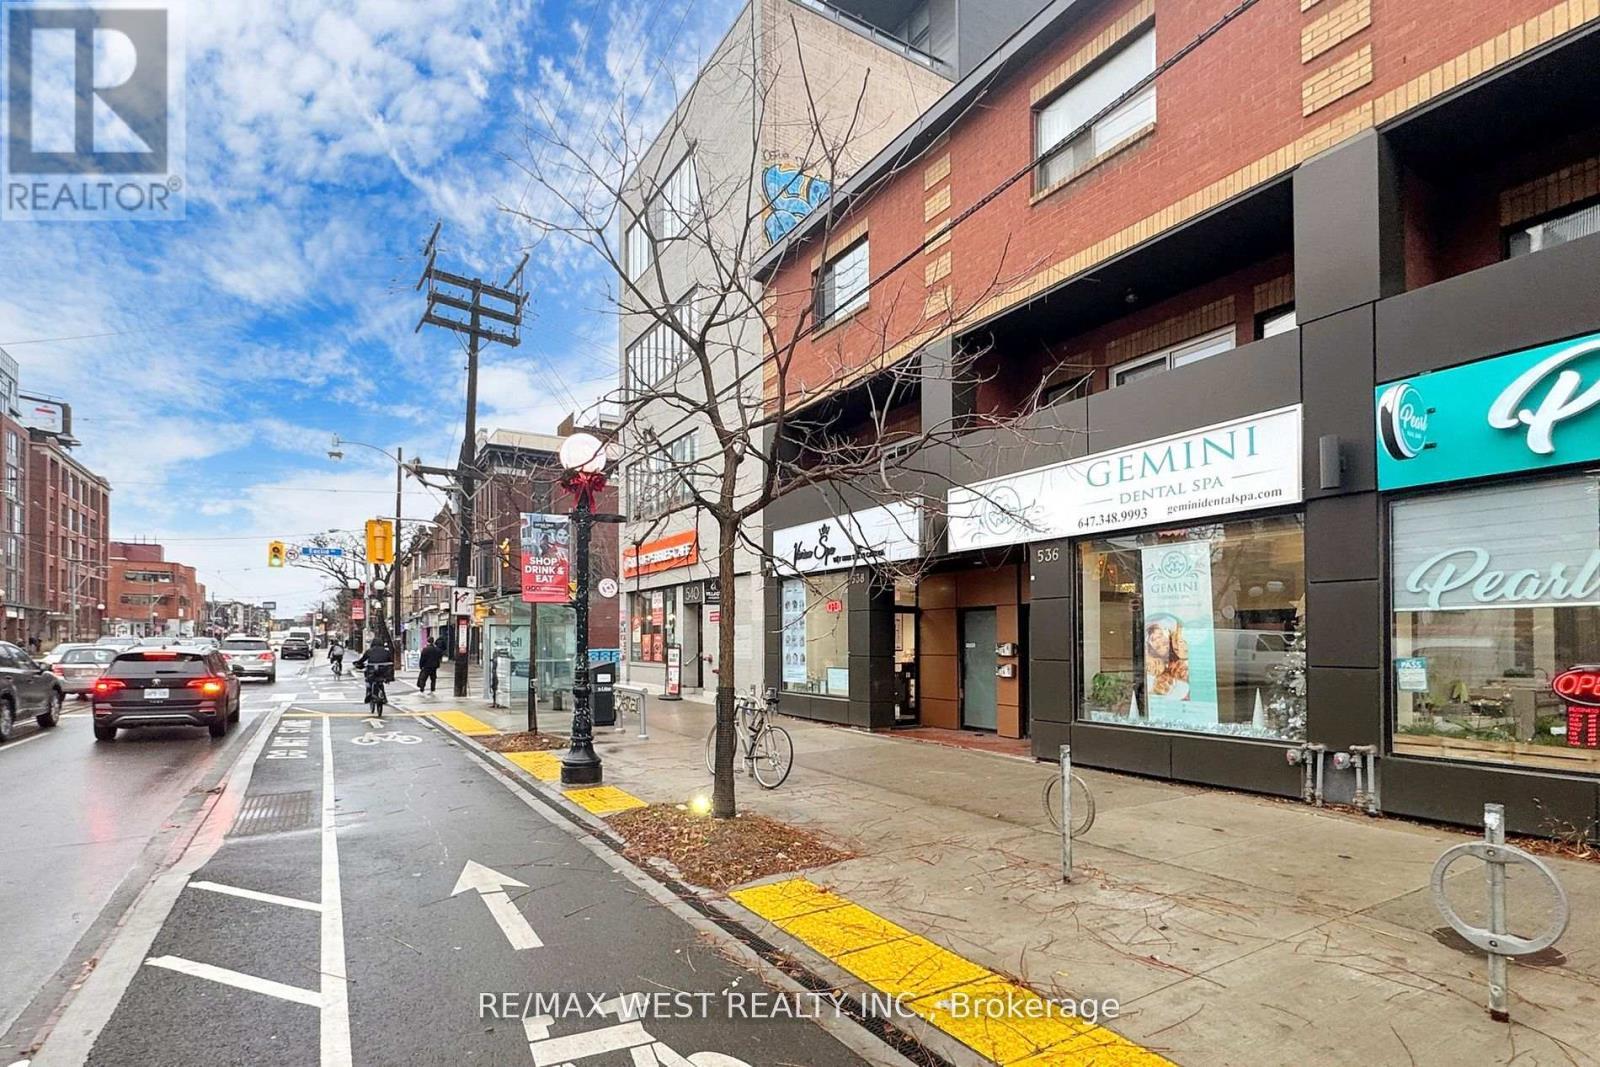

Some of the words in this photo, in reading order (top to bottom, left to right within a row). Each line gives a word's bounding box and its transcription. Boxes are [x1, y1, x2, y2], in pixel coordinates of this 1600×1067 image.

[1400, 403, 1428, 432] Pearl
[1086, 426, 1259, 487] GEMINI
[1119, 483, 1186, 505] DENTAL
[1192, 476, 1224, 491] SPA
[1077, 507, 1148, 529] 647.348.9993
[1167, 487, 1283, 514] geminidentalspa.com
[529, 557, 557, 566] SHOP
[1037, 548, 1059, 562] 536
[525, 565, 555, 575] DRINK
[557, 567, 565, 575] &
[535, 574, 554, 583] EAT
[1406, 546, 1600, 610] Pearl
[685, 586, 700, 600] 540
[1151, 582, 1199, 594] GEMINI
[1400, 661, 1422, 669] PASS
